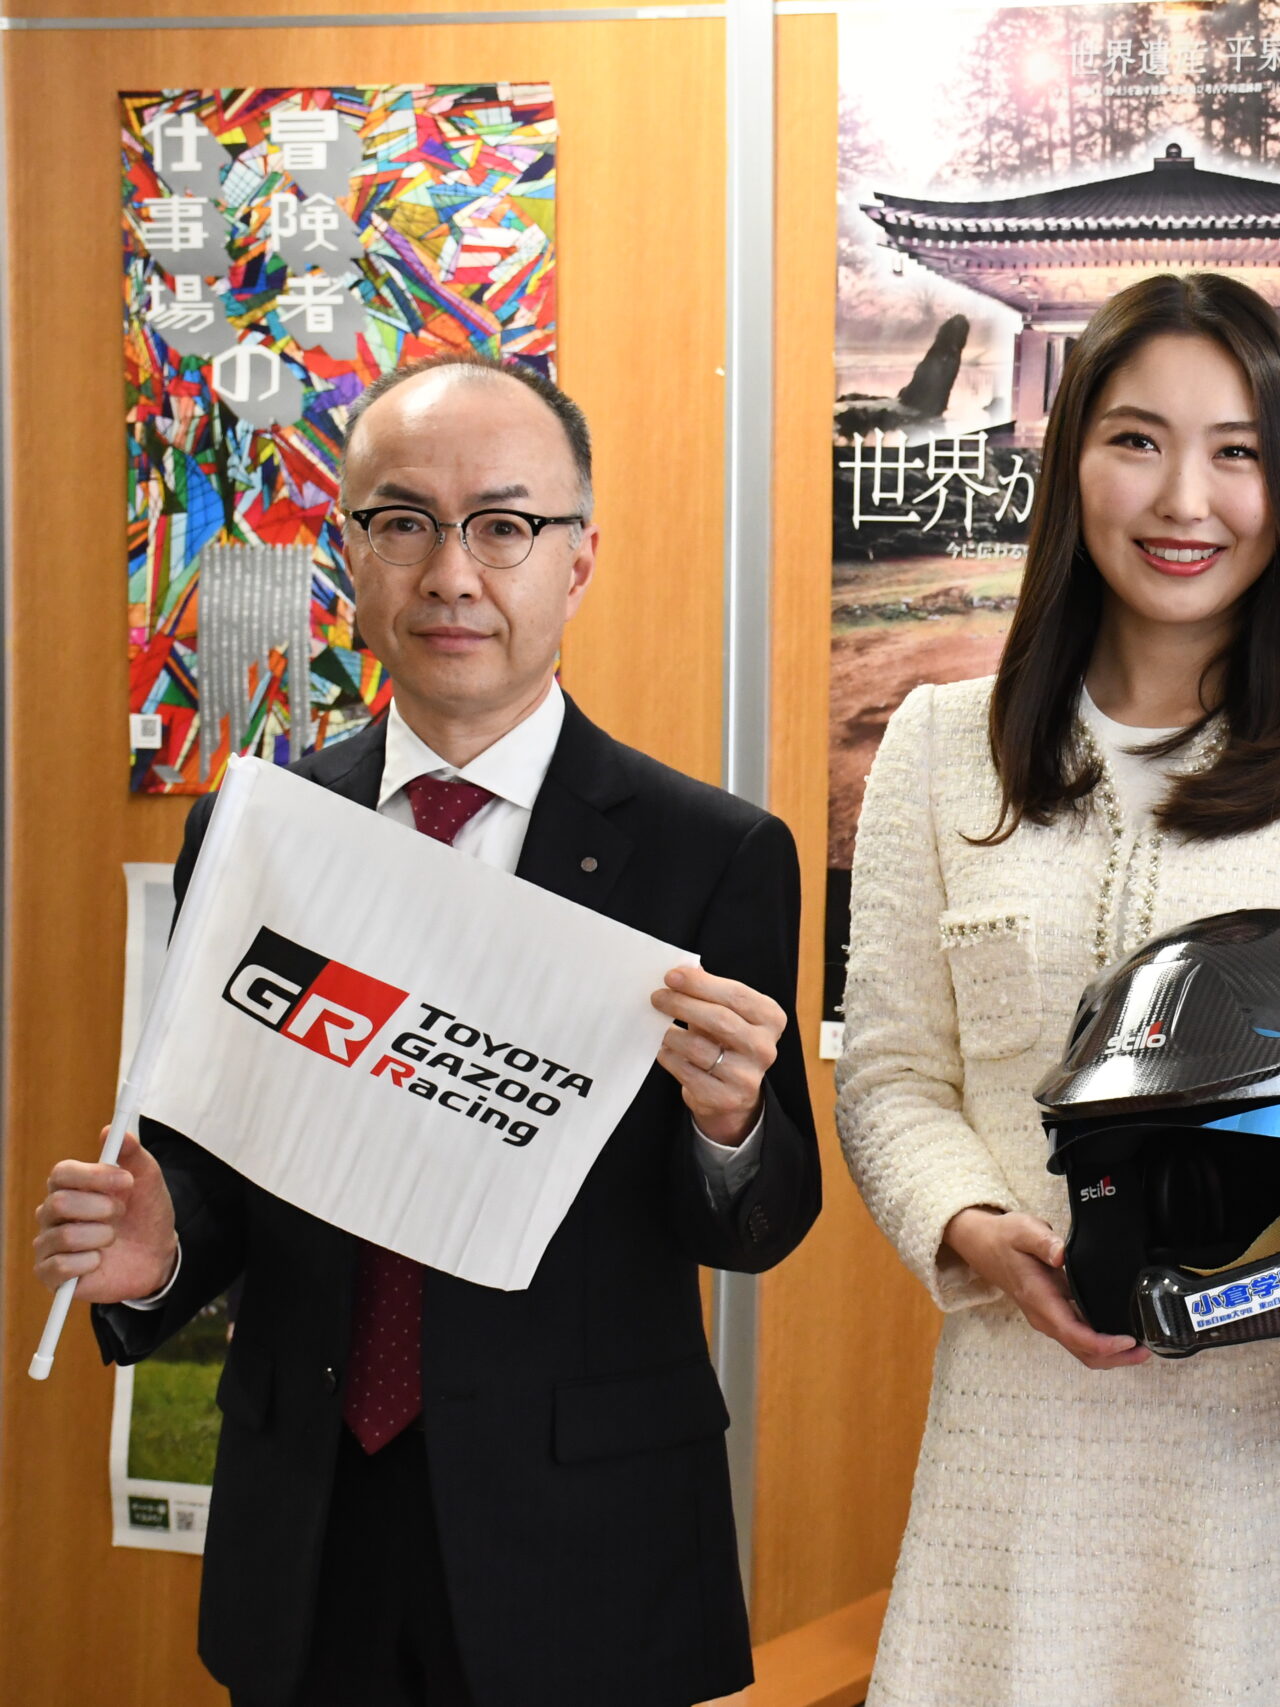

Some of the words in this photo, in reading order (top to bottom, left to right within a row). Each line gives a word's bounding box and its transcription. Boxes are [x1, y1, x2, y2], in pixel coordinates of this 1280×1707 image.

[1067, 36, 1207, 77] 世界遺産
[142, 113, 214, 333] 仕事場
[270, 110, 344, 333] 冒険者
[212, 345, 281, 402] の
[229, 963, 374, 1062] GR
[419, 1001, 594, 1099] TOYOTA
[369, 1053, 540, 1148] Racing
[390, 1031, 562, 1117] GAZOO
